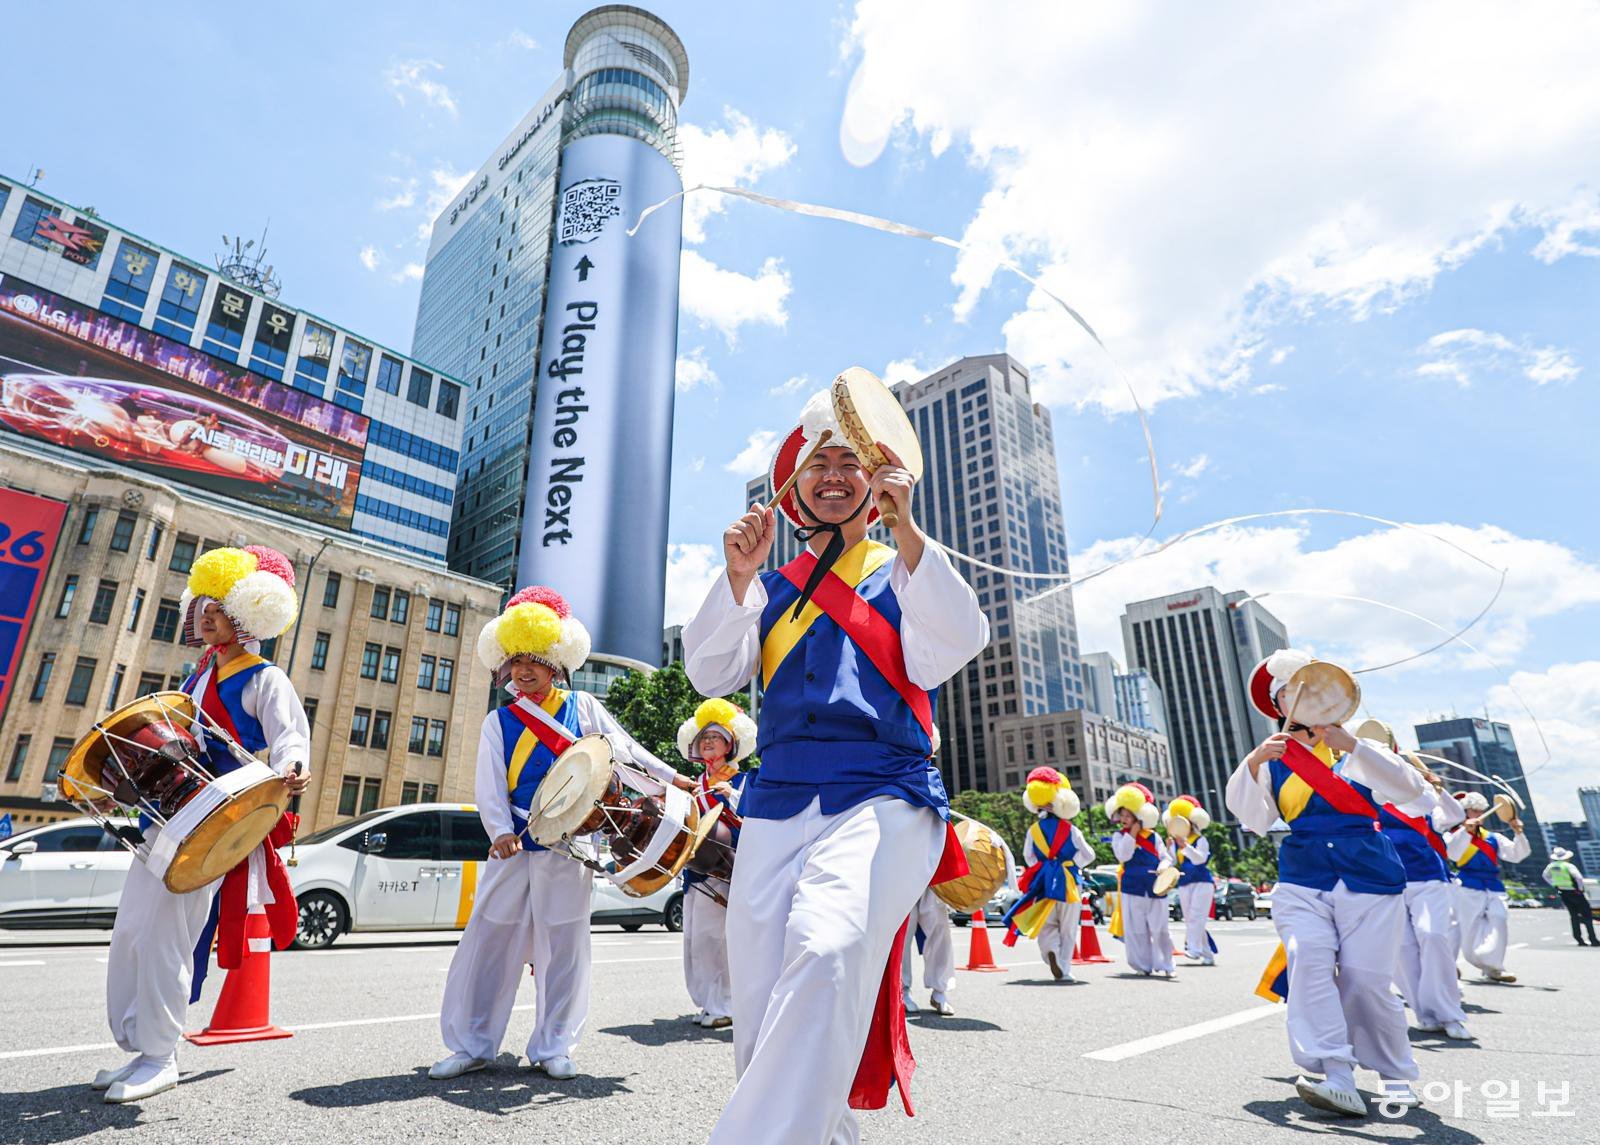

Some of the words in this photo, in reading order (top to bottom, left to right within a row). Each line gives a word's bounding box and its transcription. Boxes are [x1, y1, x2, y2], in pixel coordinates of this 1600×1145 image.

[65, 250, 91, 264] POST
[40, 305, 67, 323] LG
[548, 301, 598, 380] Play
[554, 386, 589, 448] the
[284, 444, 348, 489] 미래
[543, 455, 586, 548] Next
[378, 881, 408, 893] 카카오
[411, 881, 420, 891] T
